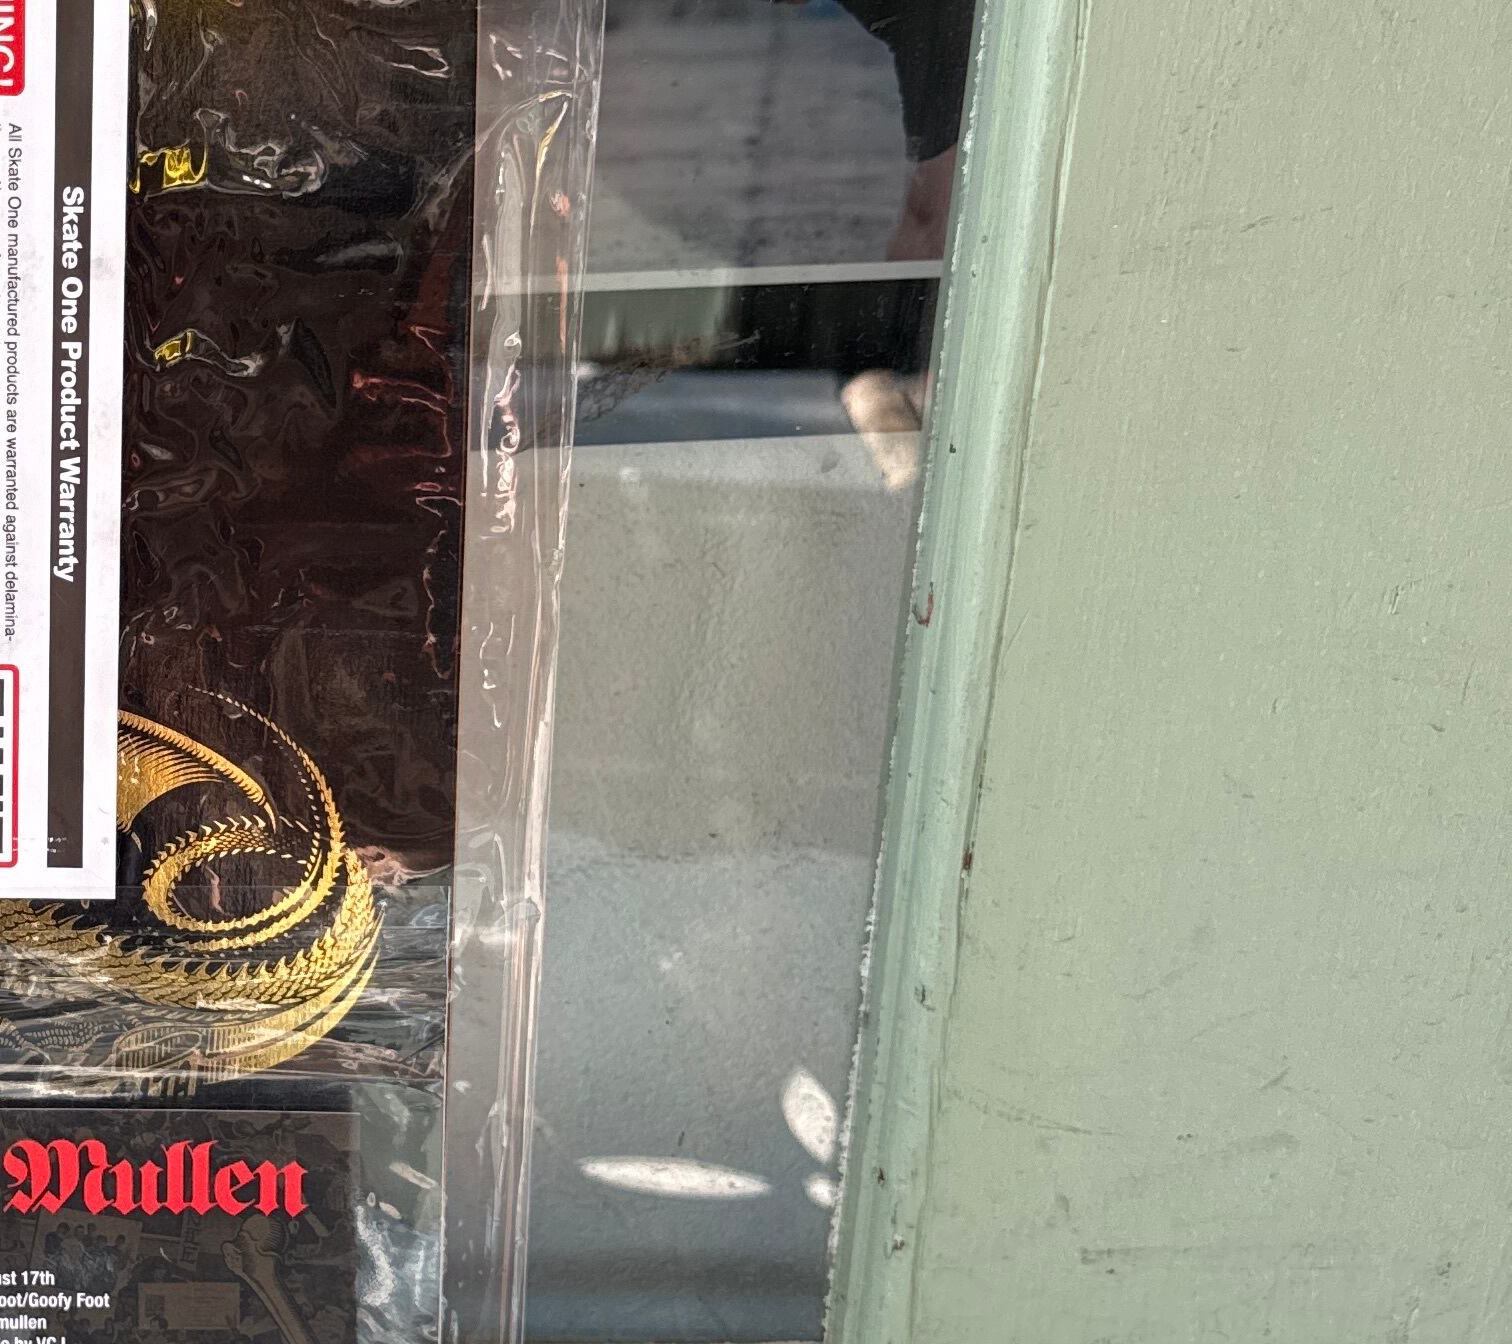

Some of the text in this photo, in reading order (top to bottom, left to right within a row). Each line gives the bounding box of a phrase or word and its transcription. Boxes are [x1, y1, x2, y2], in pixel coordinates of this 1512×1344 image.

[1, 122, 22, 642] All Skate One manufactured products are warranted against delamina-
[51, 185, 84, 583] Skate One Product Warranty
[2, 1139, 308, 1219] Mullen
[20, 1270, 55, 1286] 17th
[76, 1292, 110, 1308] Foot
